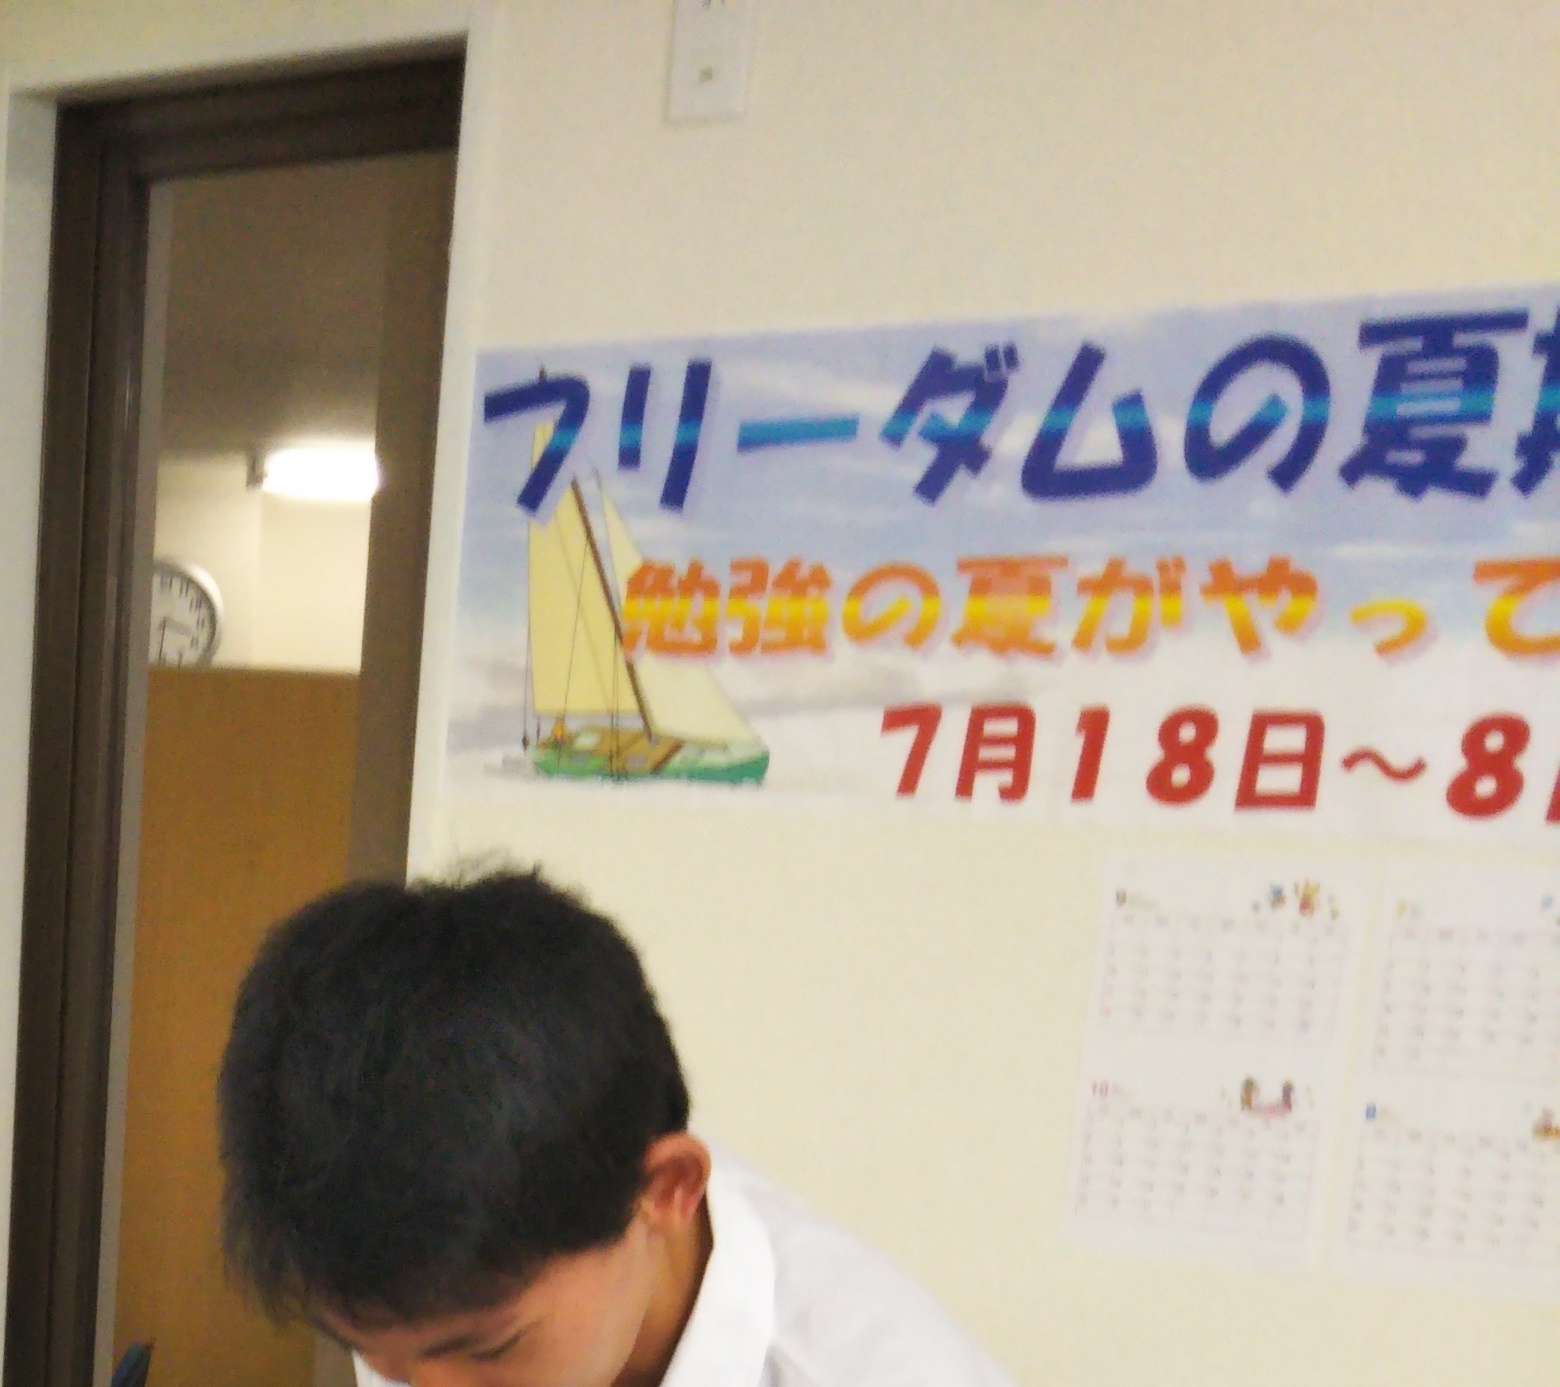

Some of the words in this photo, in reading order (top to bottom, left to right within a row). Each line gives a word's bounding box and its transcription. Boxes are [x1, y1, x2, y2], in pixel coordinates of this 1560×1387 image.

[484, 300, 1560, 515] フリーダムの夏
[879, 700, 1560, 825] 7月18日～8
